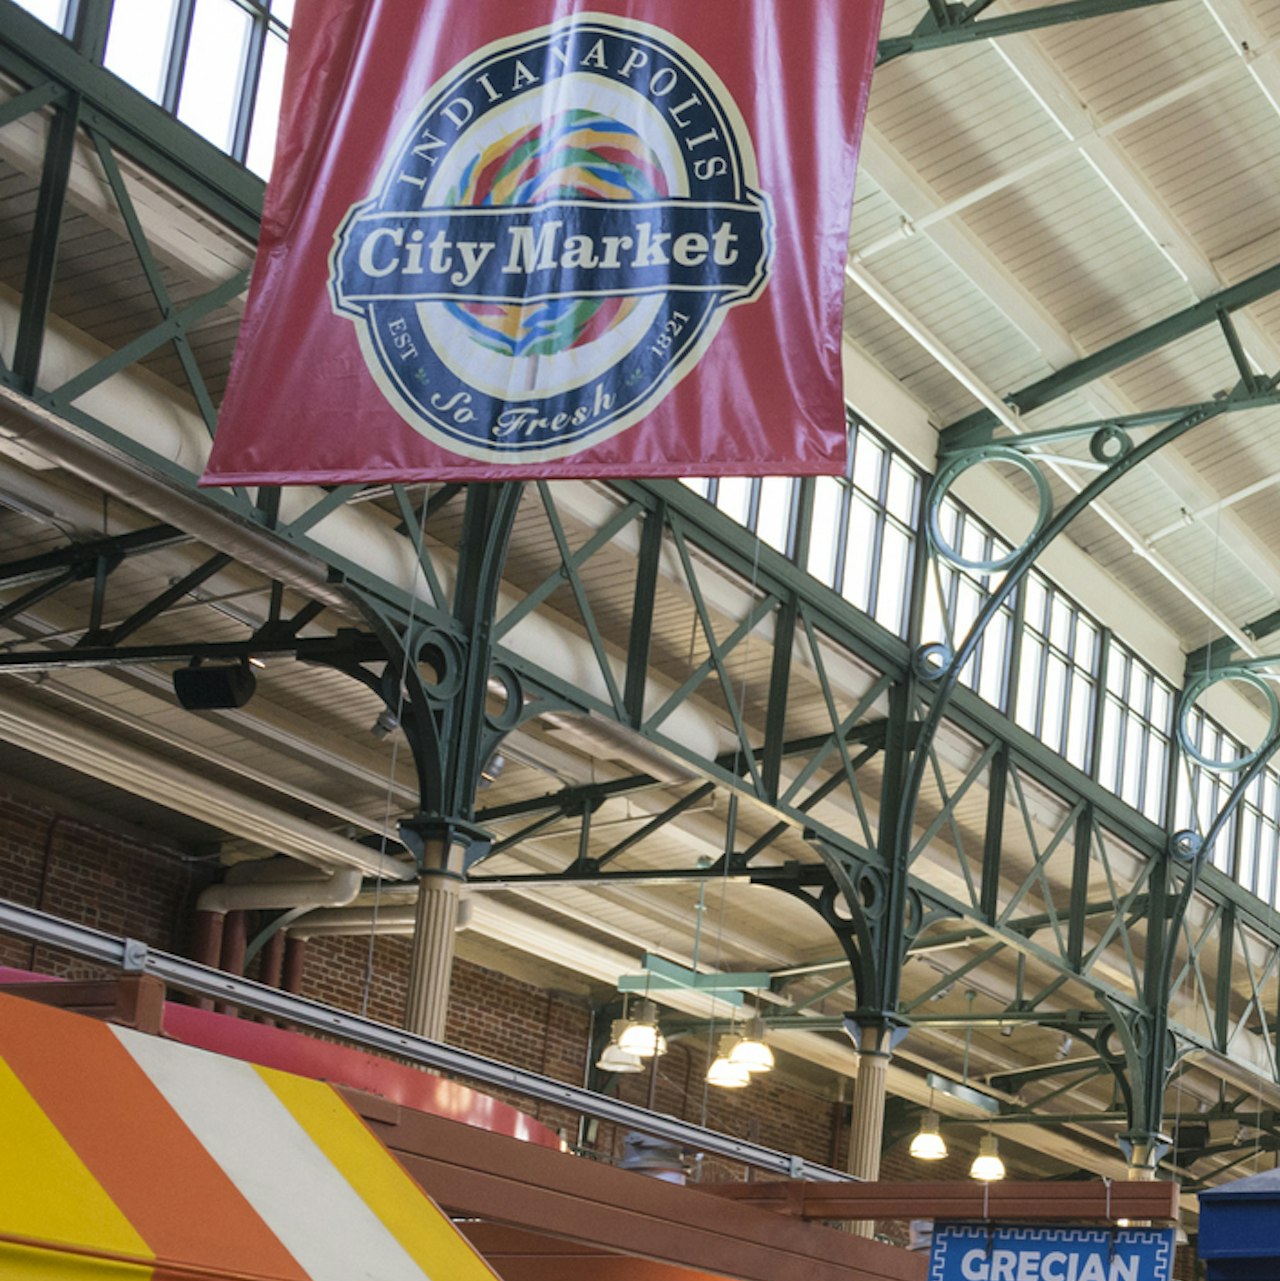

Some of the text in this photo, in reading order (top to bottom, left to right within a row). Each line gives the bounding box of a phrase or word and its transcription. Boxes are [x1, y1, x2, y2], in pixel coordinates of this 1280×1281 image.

[398, 38, 728, 190] INDIANAPOLIS
[357, 219, 740, 287] City Market
[387, 317, 420, 363] EST
[648, 309, 690, 359] 1821
[431, 382, 619, 438] So Fresh
